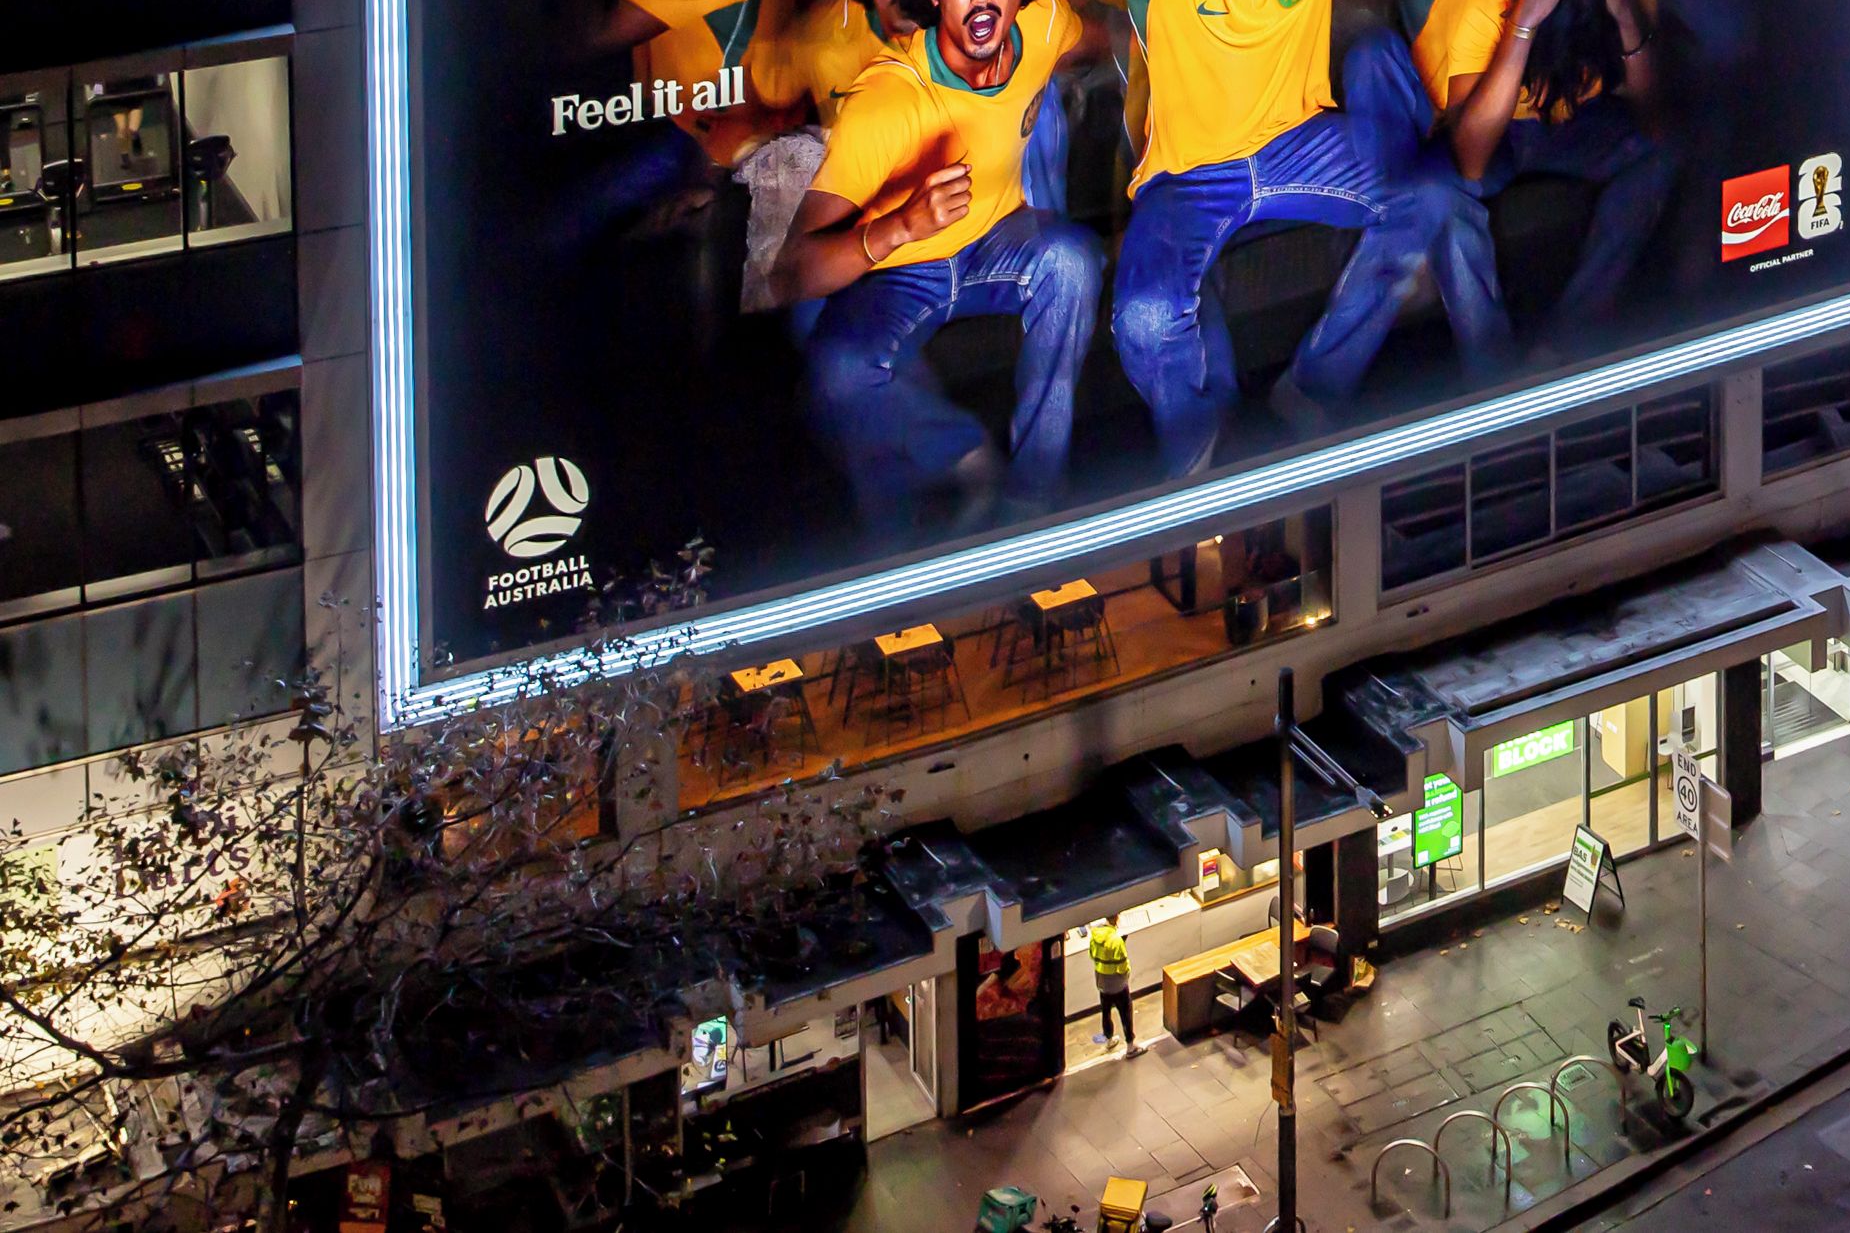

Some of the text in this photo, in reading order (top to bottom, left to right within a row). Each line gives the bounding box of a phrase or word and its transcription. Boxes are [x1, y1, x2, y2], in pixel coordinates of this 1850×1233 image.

[551, 66, 746, 136] Feel it all
[1810, 217, 1830, 230] FIFA
[1749, 248, 1814, 273] OFFICIAL PARTNER
[488, 555, 589, 591] FOOTBALL
[484, 571, 593, 609] AUSTRALIA
[1498, 729, 1571, 771] BLOCK
[1677, 753, 1697, 778] END
[1680, 784, 1695, 806] 40
[1676, 811, 1698, 836] AREA
